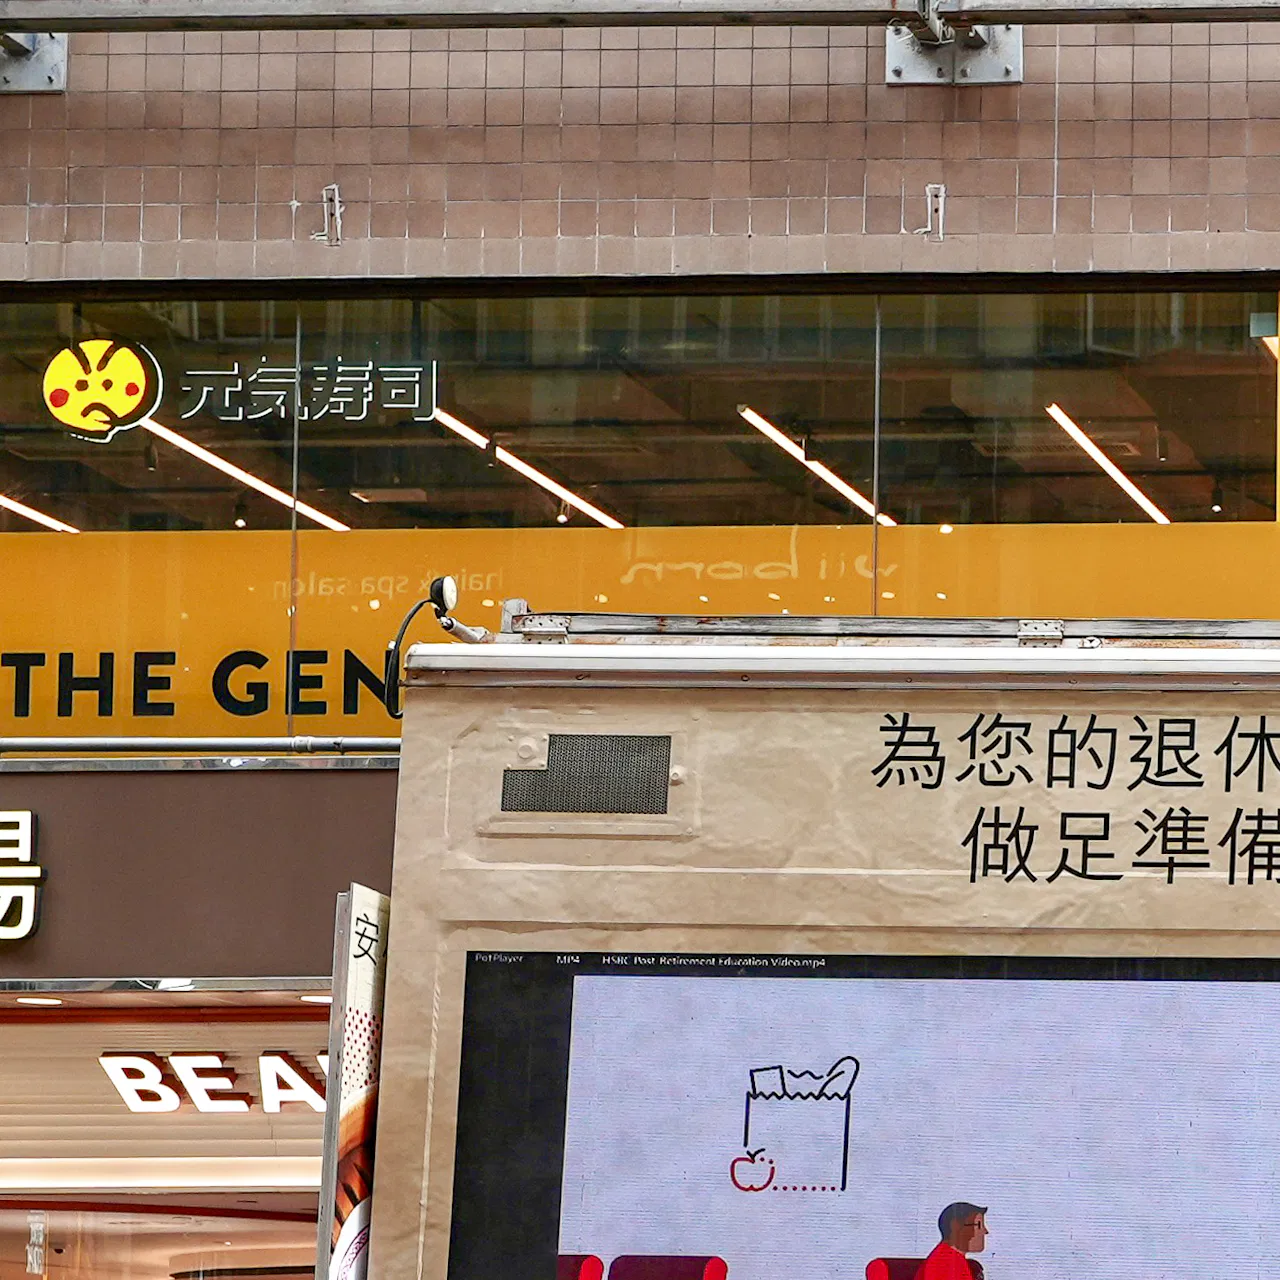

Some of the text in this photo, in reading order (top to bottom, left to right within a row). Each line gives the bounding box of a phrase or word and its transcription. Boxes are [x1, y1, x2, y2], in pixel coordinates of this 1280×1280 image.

[180, 355, 438, 421] 元気寿司
[0, 652, 176, 717] THE
[99, 1055, 329, 1113] BEA
